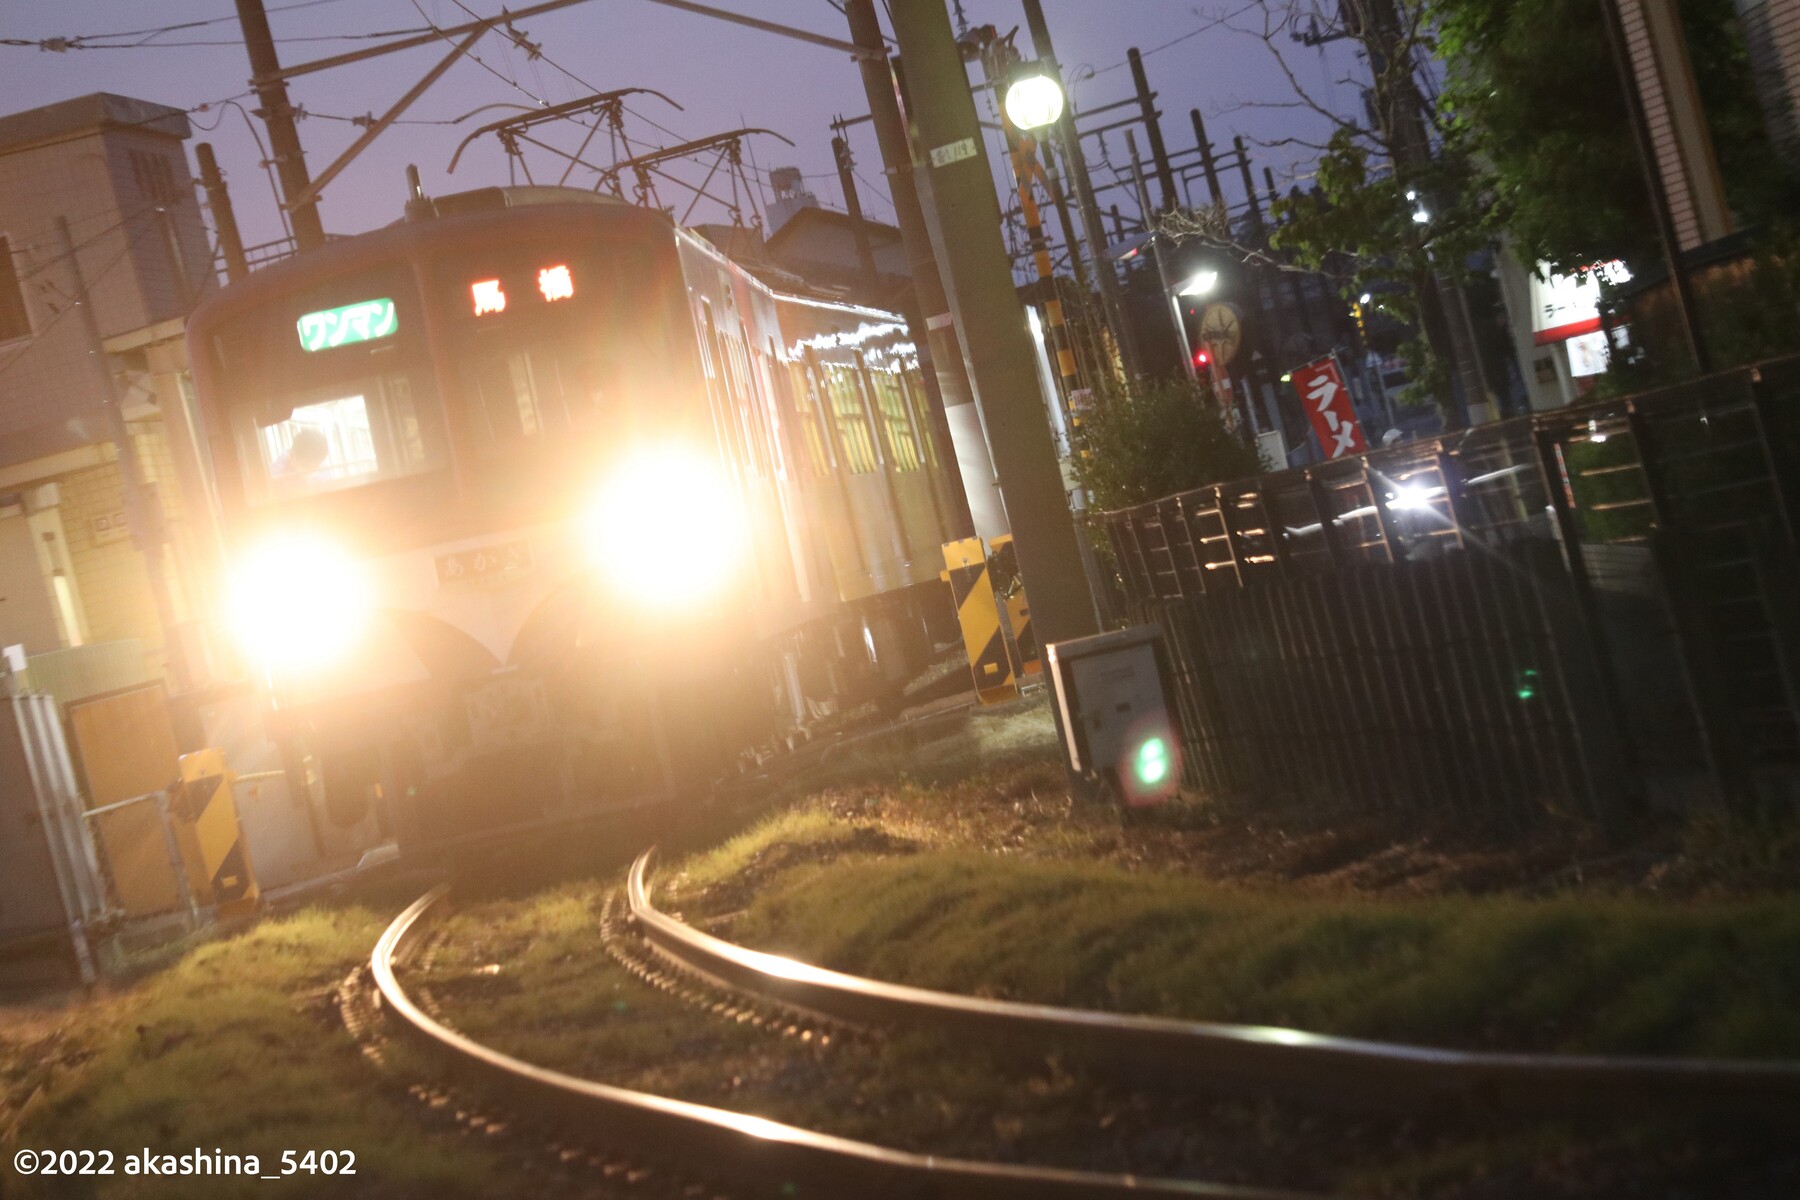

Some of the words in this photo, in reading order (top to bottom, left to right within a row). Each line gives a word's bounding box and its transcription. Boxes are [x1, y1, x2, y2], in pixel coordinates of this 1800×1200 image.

[301, 301, 395, 352] ワンマン
[1306, 374, 1356, 458] ラーメ
